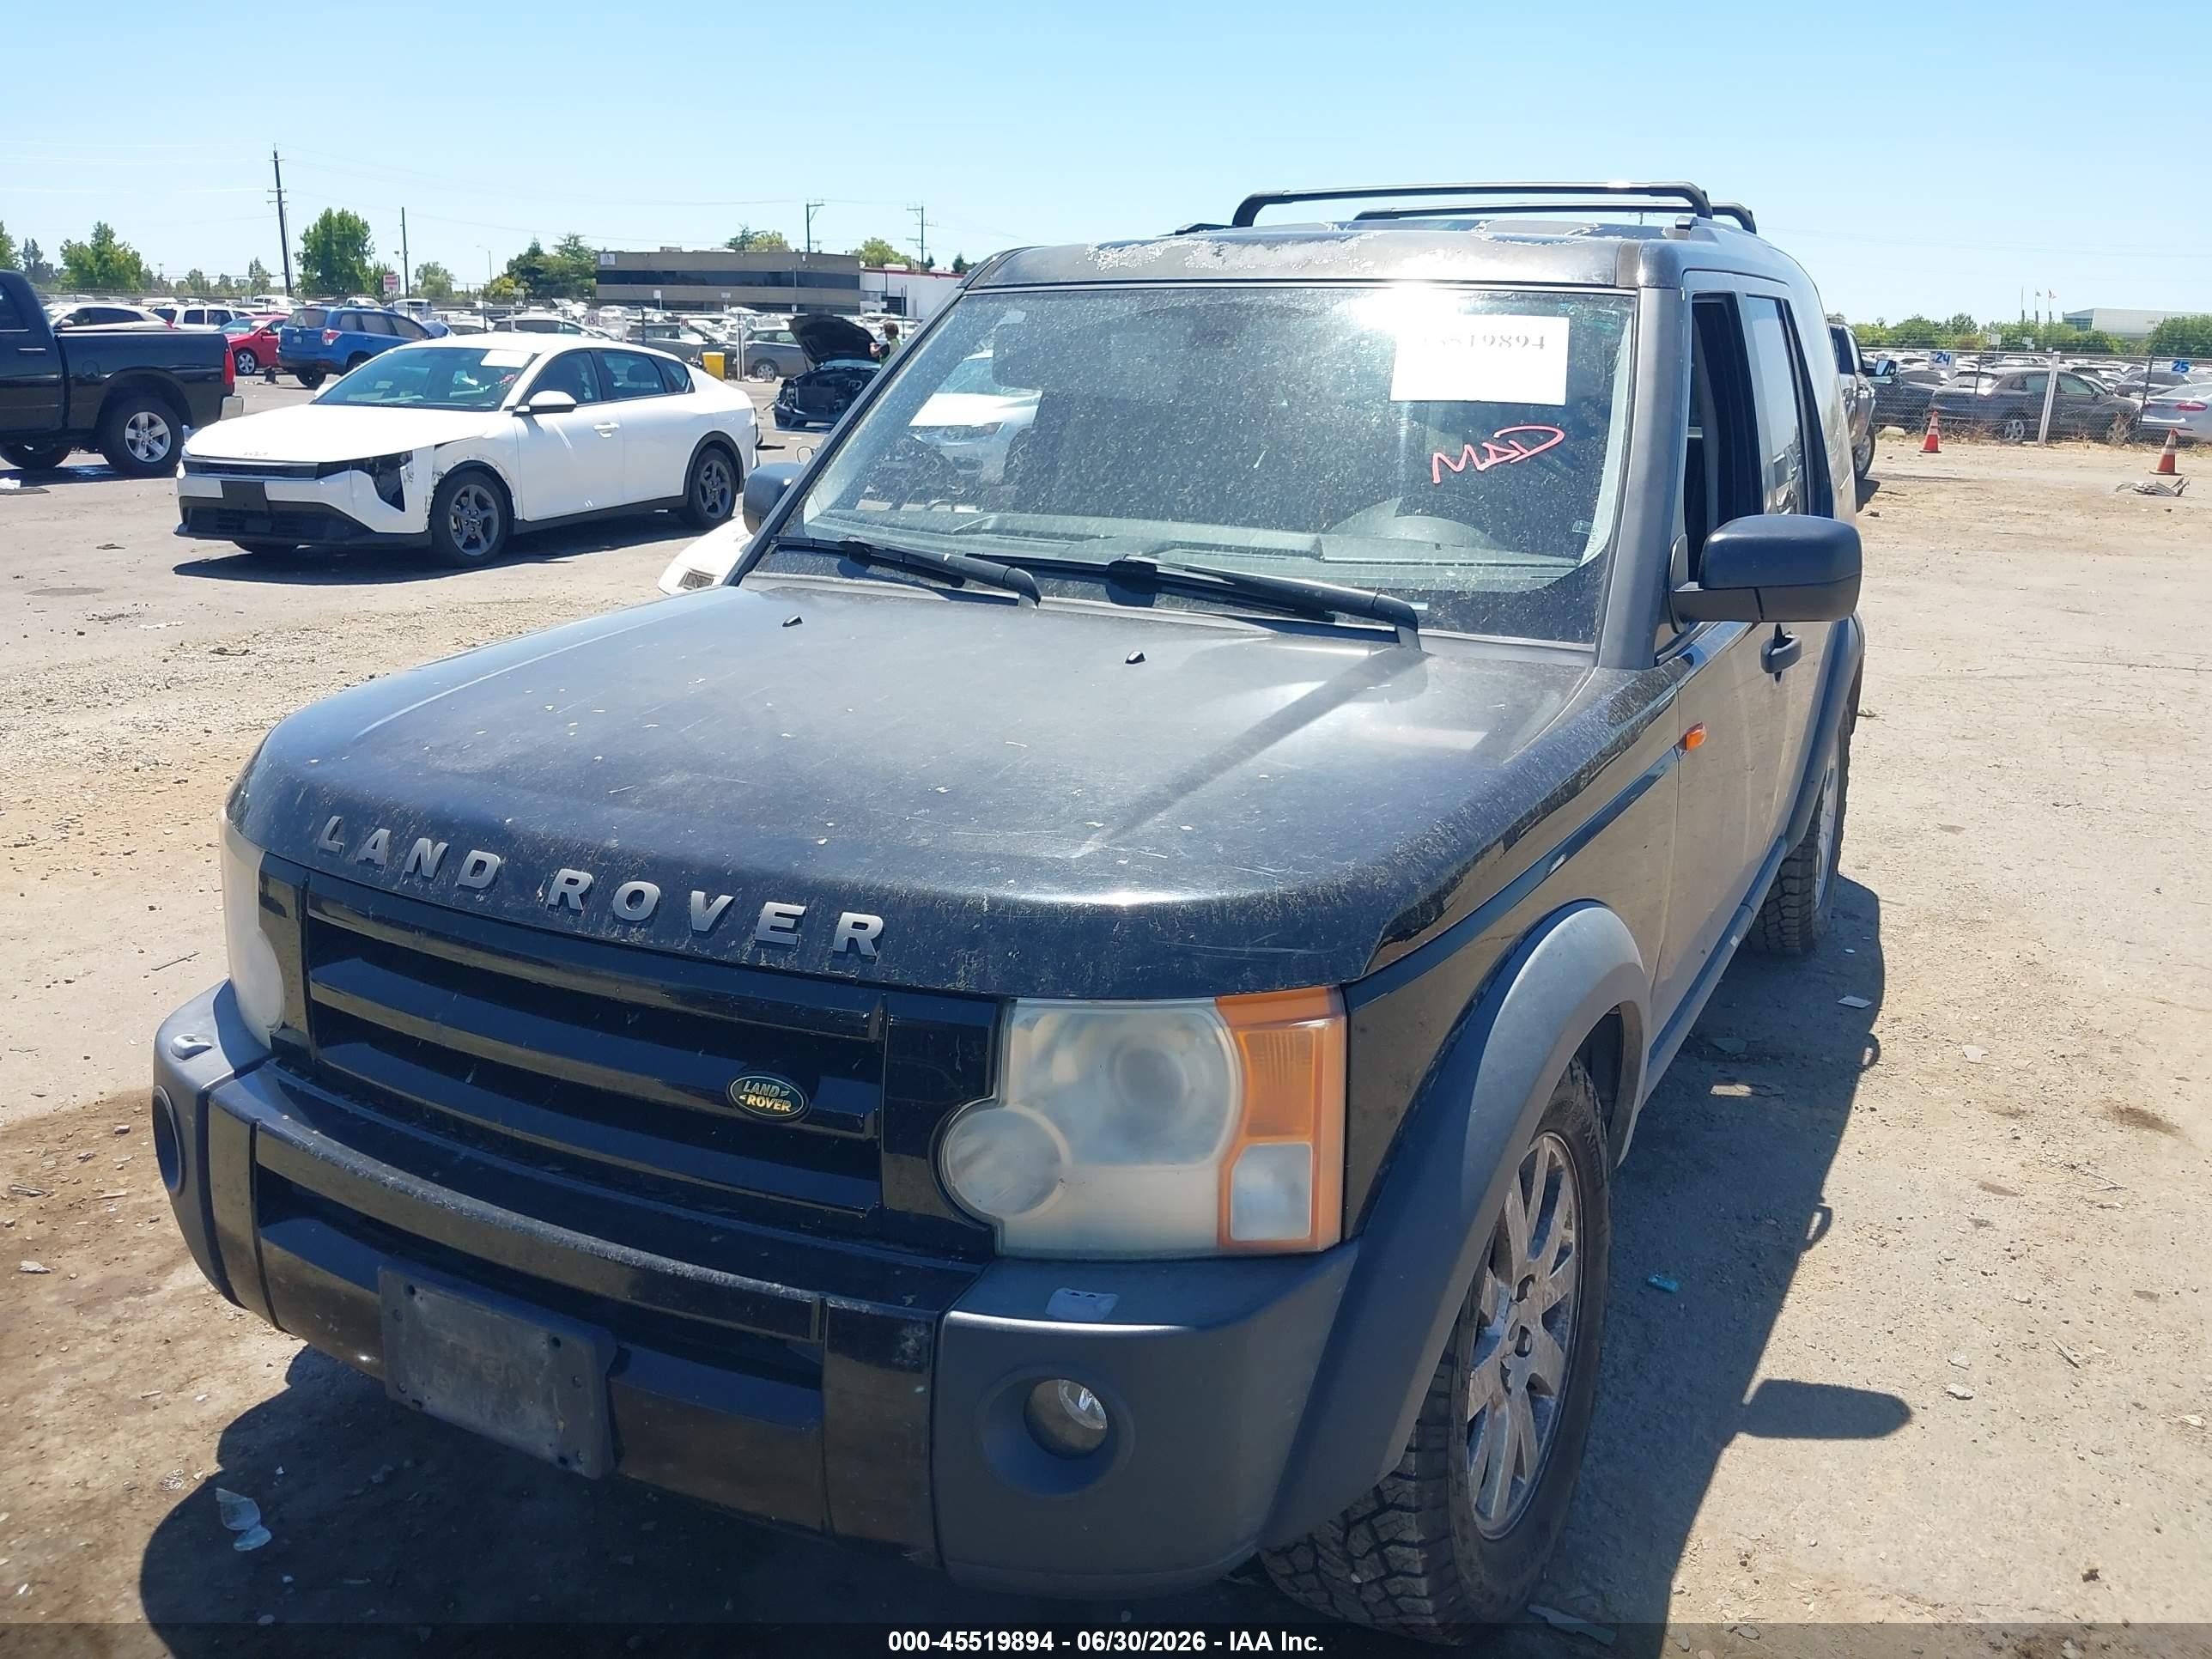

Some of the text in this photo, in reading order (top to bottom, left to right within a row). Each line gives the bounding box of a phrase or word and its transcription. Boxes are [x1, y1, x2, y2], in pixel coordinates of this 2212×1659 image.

[1935, 352, 1951, 366] 24
[2172, 360, 2189, 374] 25
[316, 815, 884, 960] LAND ROVER
[743, 1080, 781, 1097] LAND
[746, 1094, 792, 1112] ROVER
